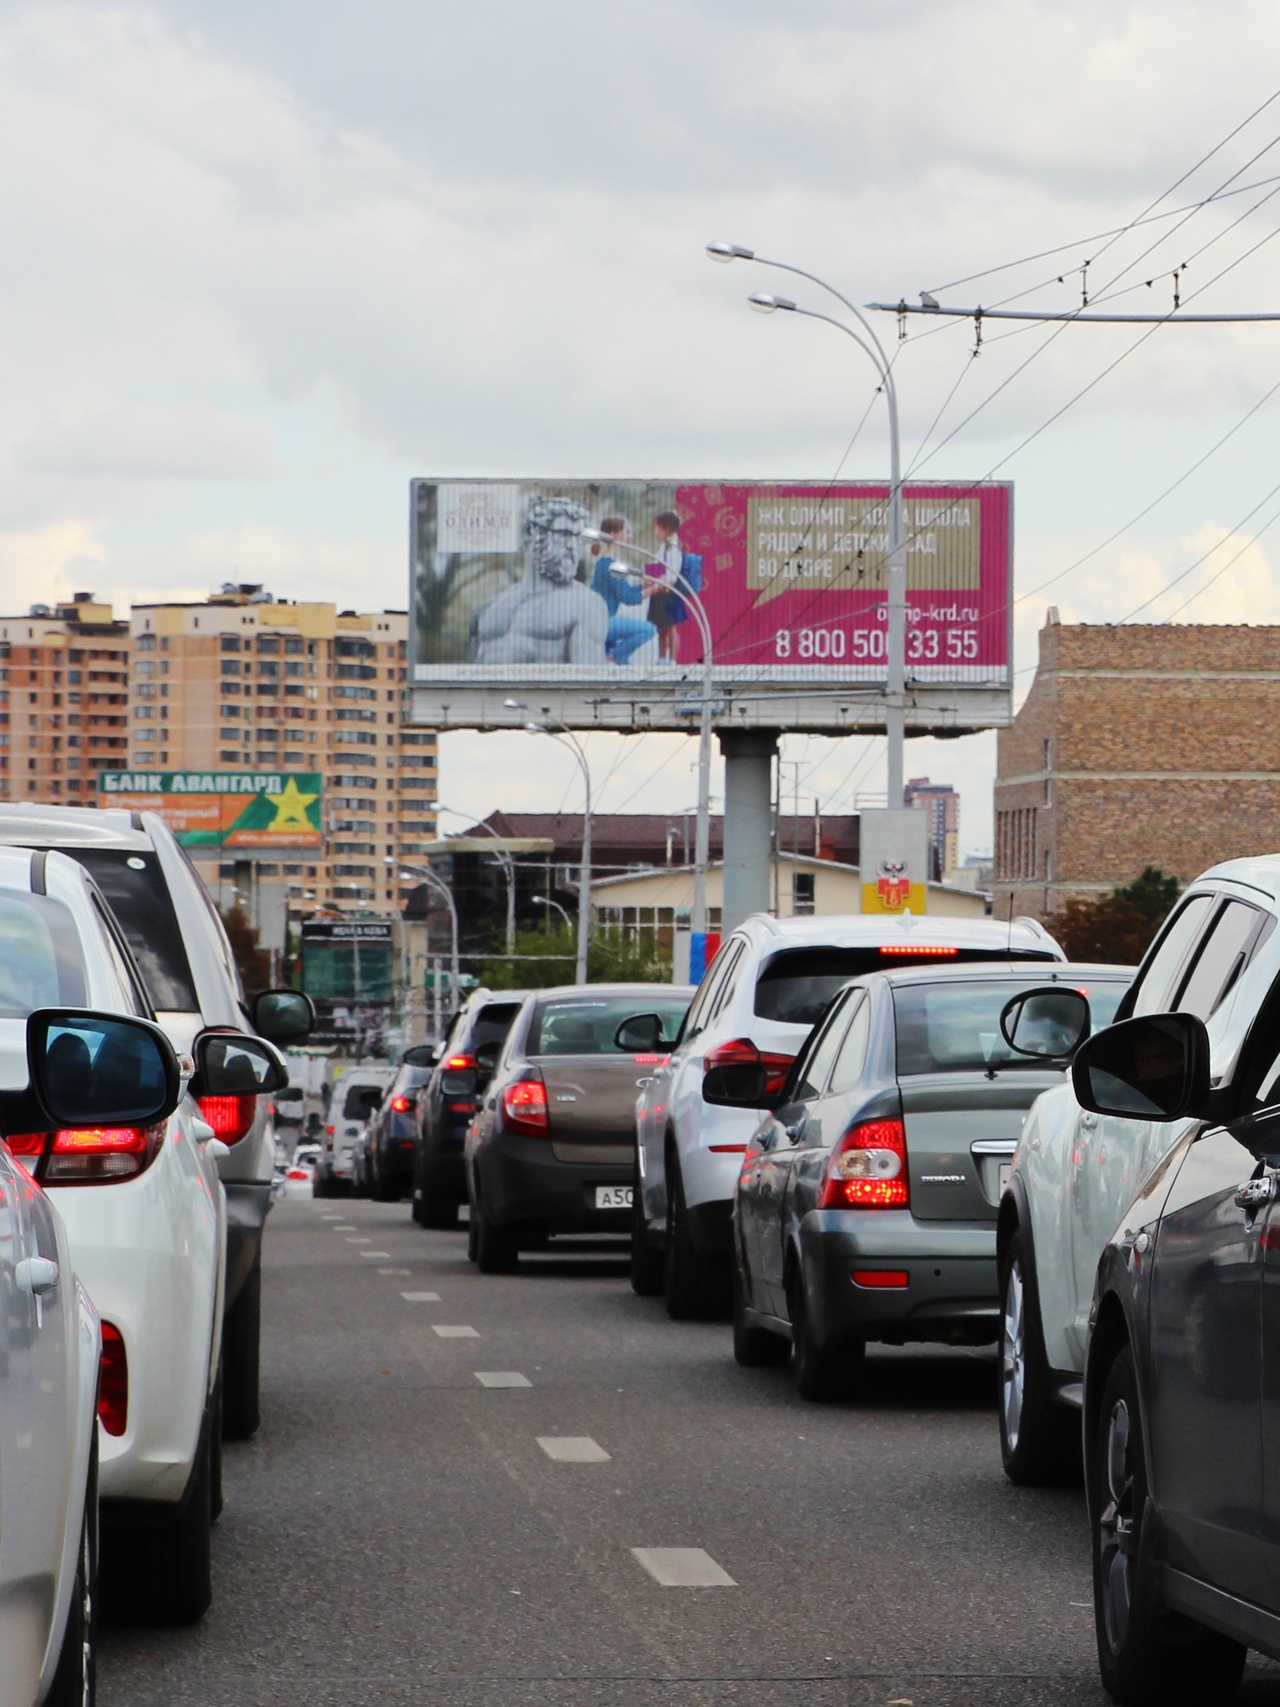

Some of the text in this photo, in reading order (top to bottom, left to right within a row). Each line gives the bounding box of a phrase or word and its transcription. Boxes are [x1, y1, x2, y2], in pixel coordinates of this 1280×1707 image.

[758, 506, 784, 525] ЖК
[790, 506, 844, 526] ОЛИМП
[915, 507, 971, 526] ШКОЛА
[758, 532, 812, 554] РЯДОМ
[817, 532, 828, 552] И
[833, 532, 890, 553] ДЕТСКИ
[758, 558, 778, 578] ВО
[775, 629, 978, 659] 8 800 50 33 55
[104, 774, 283, 794] БАНК АВАНГАРД
